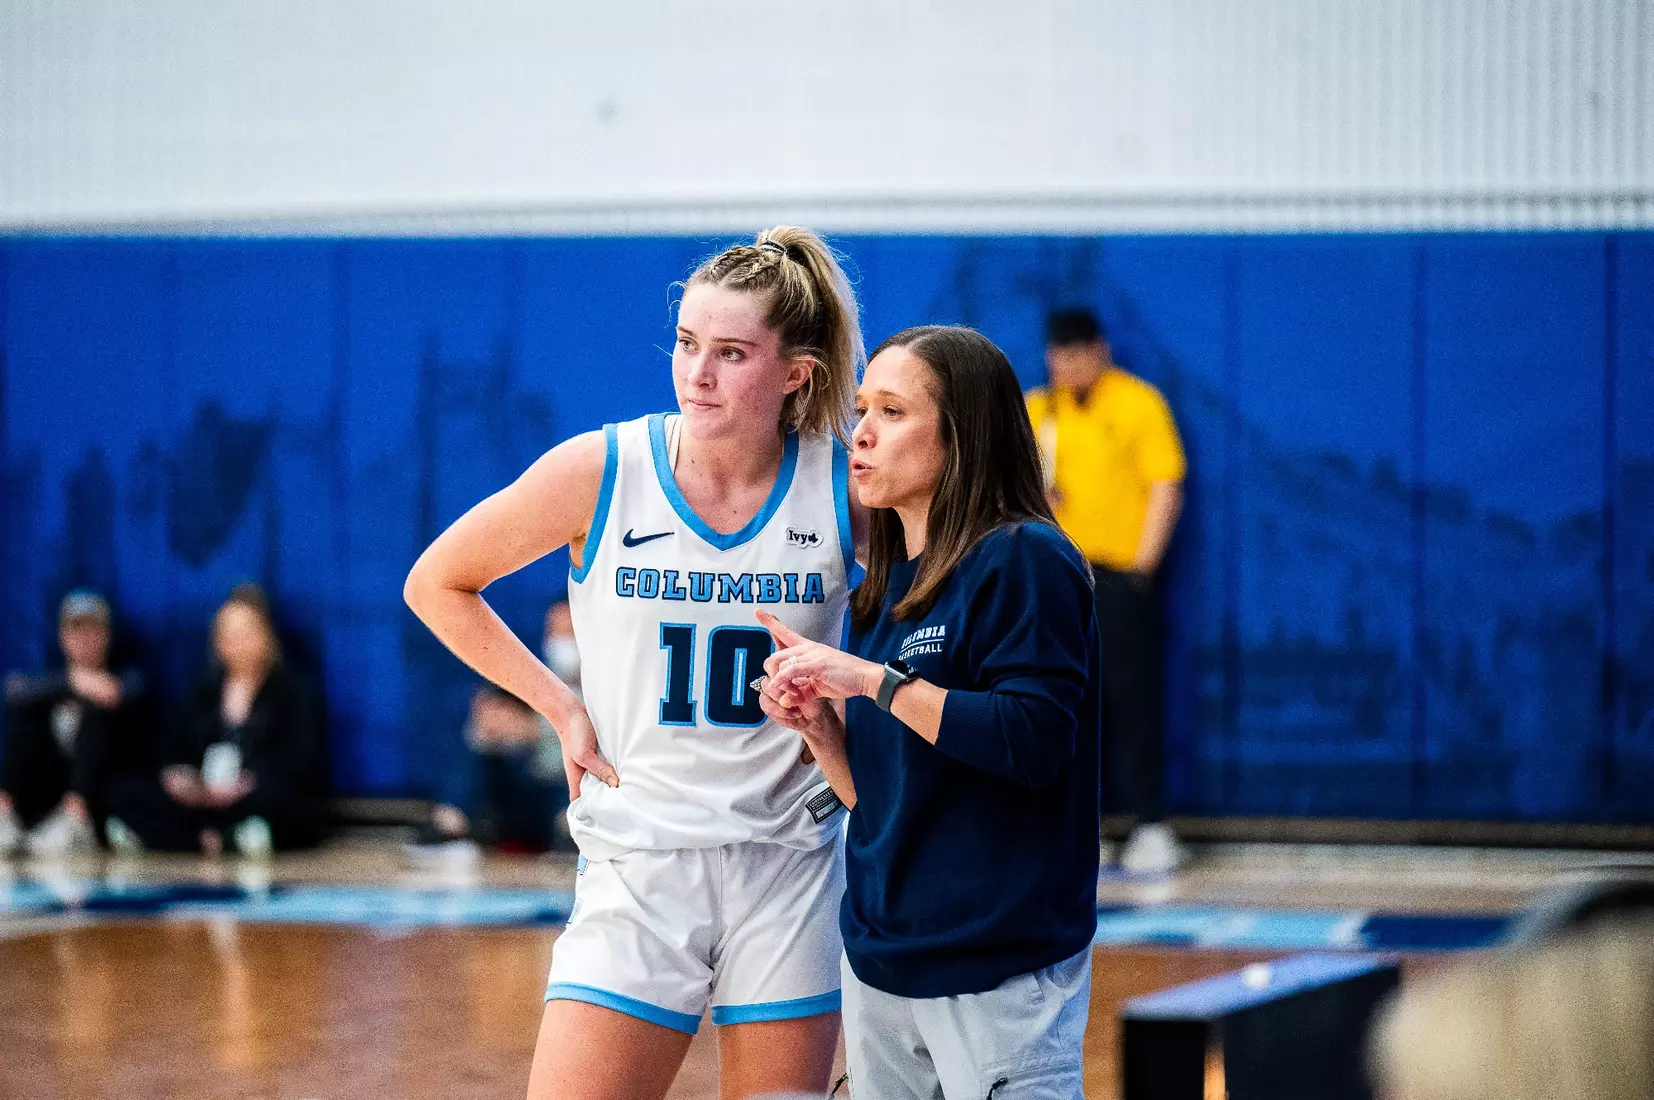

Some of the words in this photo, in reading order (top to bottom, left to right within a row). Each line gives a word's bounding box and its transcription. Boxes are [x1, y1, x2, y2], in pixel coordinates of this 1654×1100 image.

[789, 530, 807, 544] Ivy
[616, 567, 825, 604] COLUMBIA
[658, 622, 776, 728] 10
